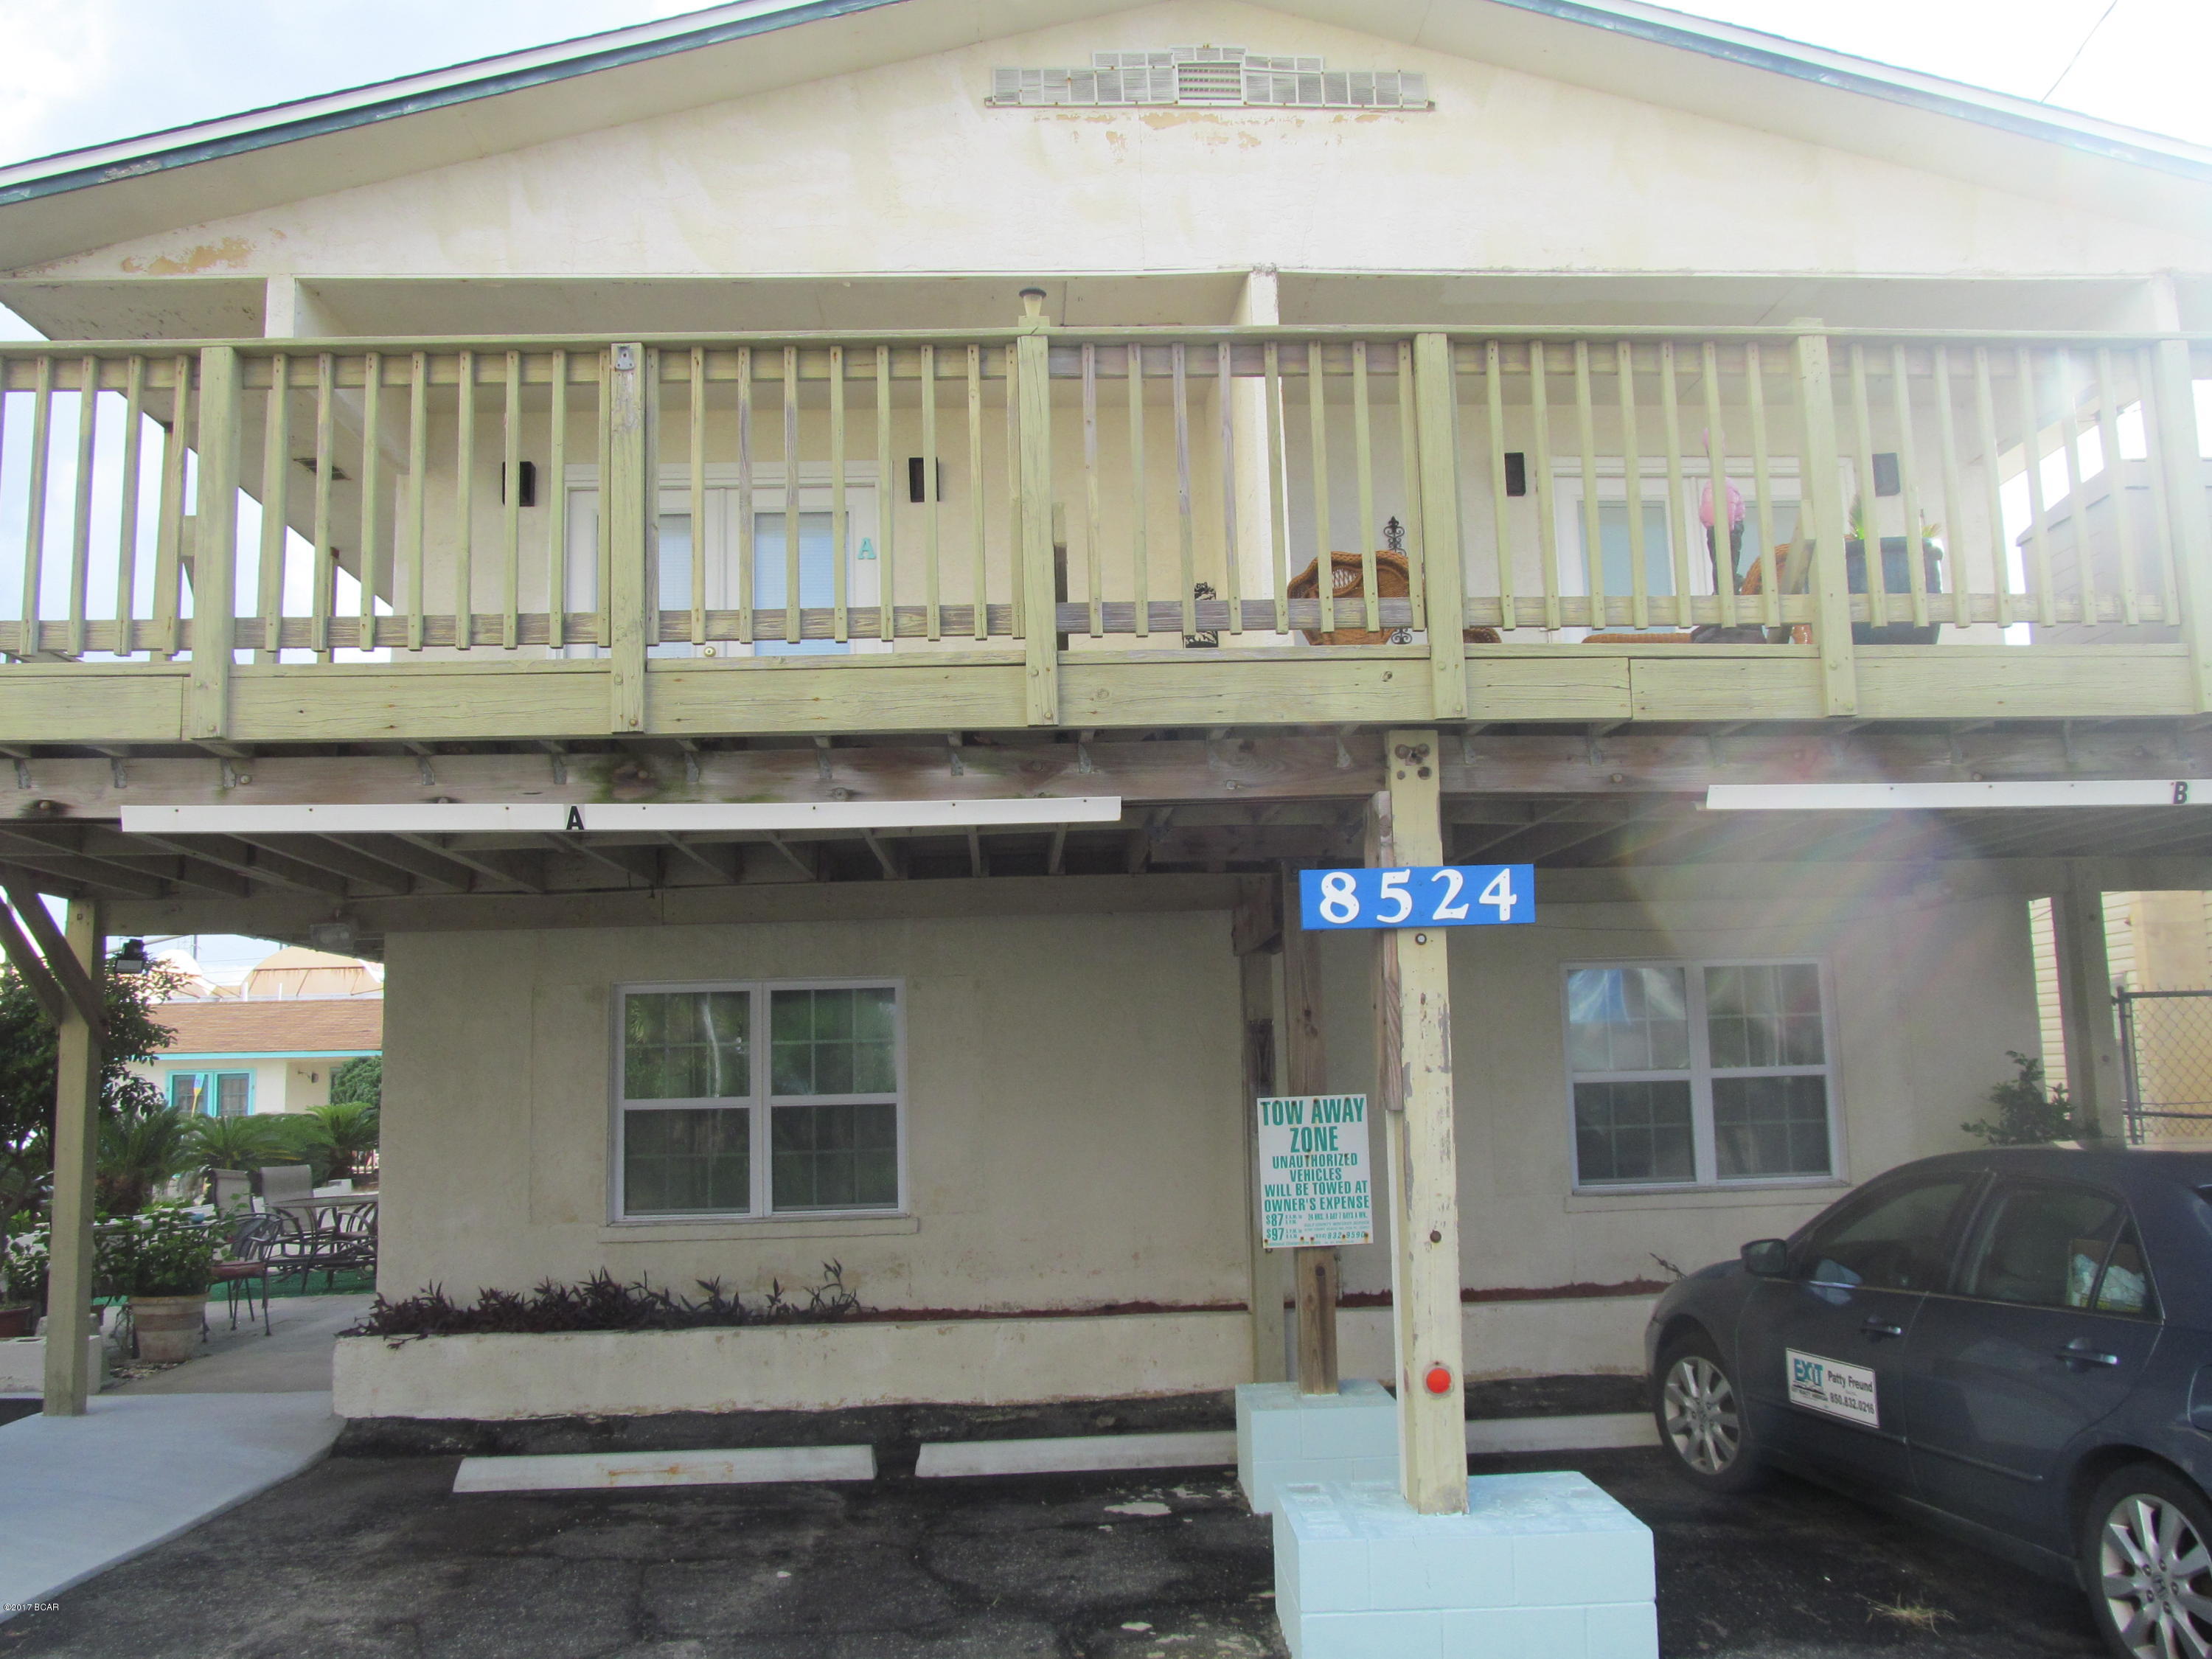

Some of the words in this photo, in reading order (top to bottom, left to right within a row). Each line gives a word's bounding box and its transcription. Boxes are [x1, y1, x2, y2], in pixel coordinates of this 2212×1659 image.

[858, 537, 877, 560] A
[2173, 781, 2188, 804] B
[566, 805, 585, 830] A
[1319, 869, 1517, 924] 8524
[1260, 1100, 1303, 1126] TOW
[1311, 1097, 1364, 1124] AWAY
[1290, 1126, 1339, 1153] ZONE
[1272, 1153, 1358, 1169] UNAUTHORIZED
[1290, 1168, 1342, 1182] VEHICLES
[1265, 1183, 1292, 1197] WILL
[1295, 1183, 1309, 1196] BE
[1312, 1181, 1352, 1195] TOWED
[1355, 1180, 1368, 1194] AT
[1265, 1197, 1316, 1213] OWNER'S
[1320, 1195, 1369, 1211] EXPENSE
[1265, 1213, 1284, 1227] $87
[1266, 1227, 1284, 1242] $97
[1828, 1370, 1846, 1388] Patty
[1848, 1375, 1874, 1393] Freund
